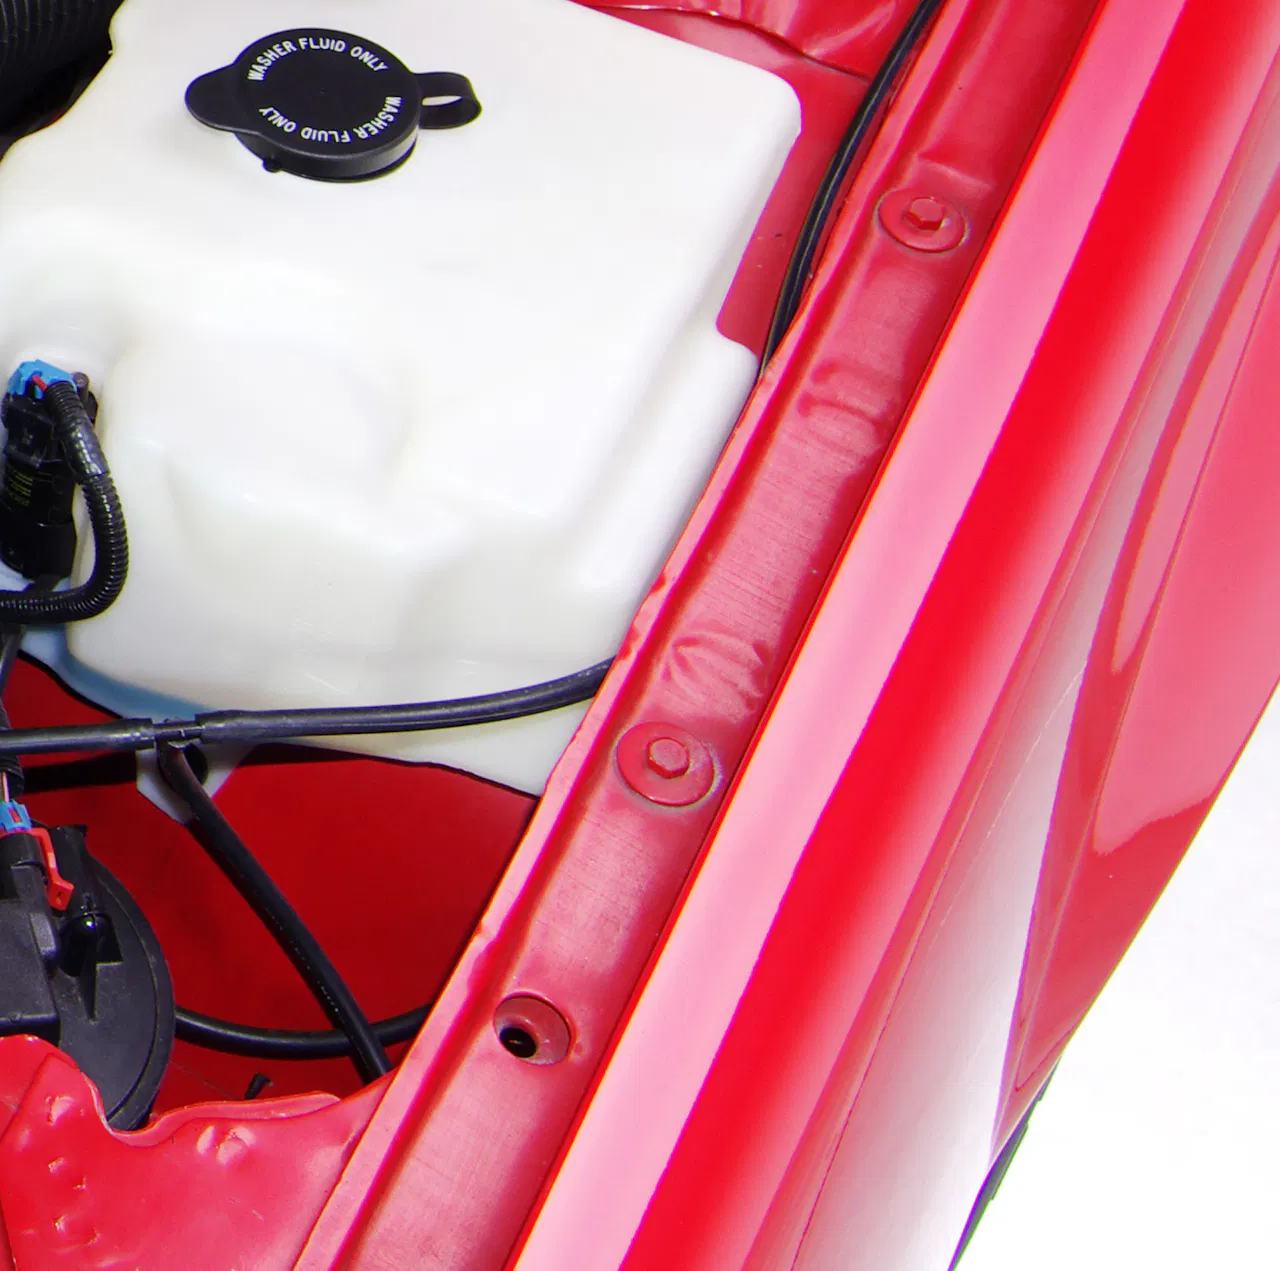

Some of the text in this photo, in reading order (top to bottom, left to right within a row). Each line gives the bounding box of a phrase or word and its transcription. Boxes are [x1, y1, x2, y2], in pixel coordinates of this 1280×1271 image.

[247, 37, 389, 81] WASHER FLUID ONLY
[258, 96, 402, 143] WASHER FLUID ONLY
